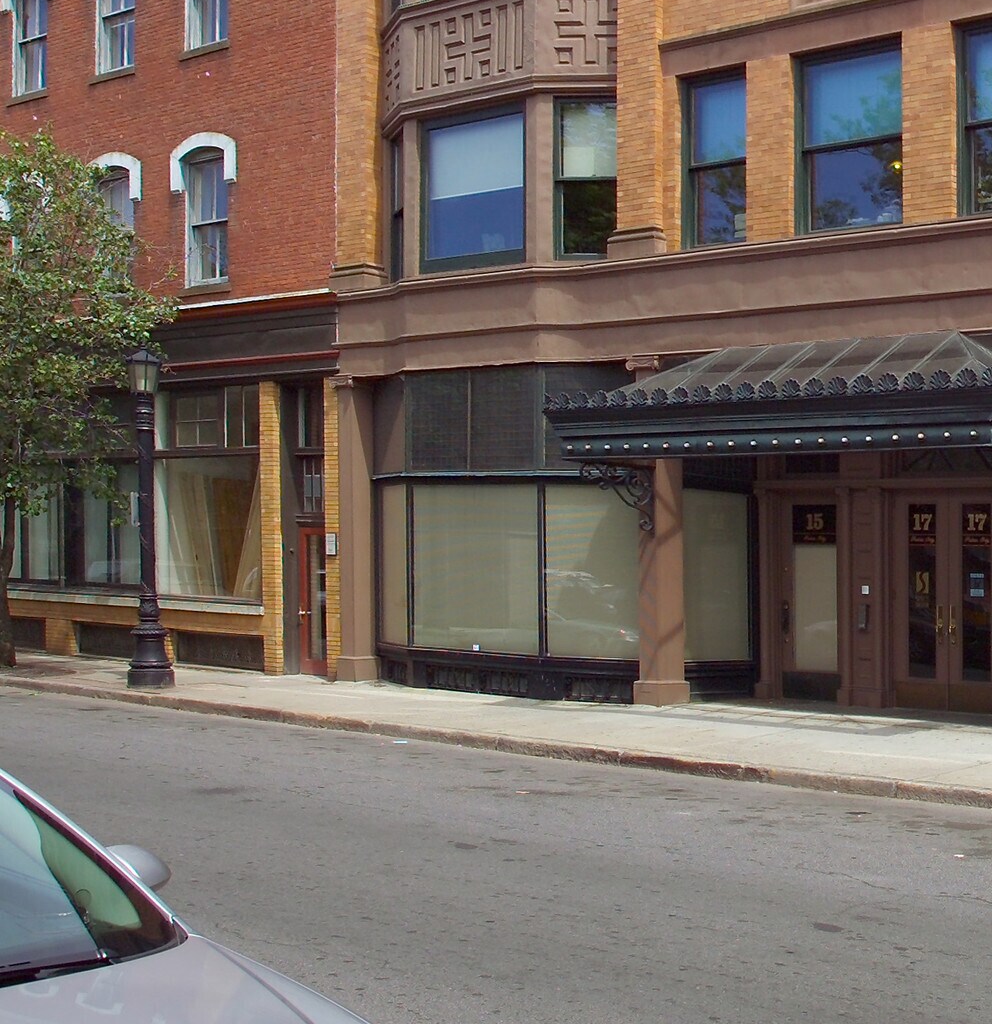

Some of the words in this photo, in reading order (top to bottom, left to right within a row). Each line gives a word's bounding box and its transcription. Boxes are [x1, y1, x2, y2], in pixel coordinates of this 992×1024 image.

[805, 513, 824, 531] 15
[912, 513, 932, 531] 17
[967, 513, 987, 531] 17
